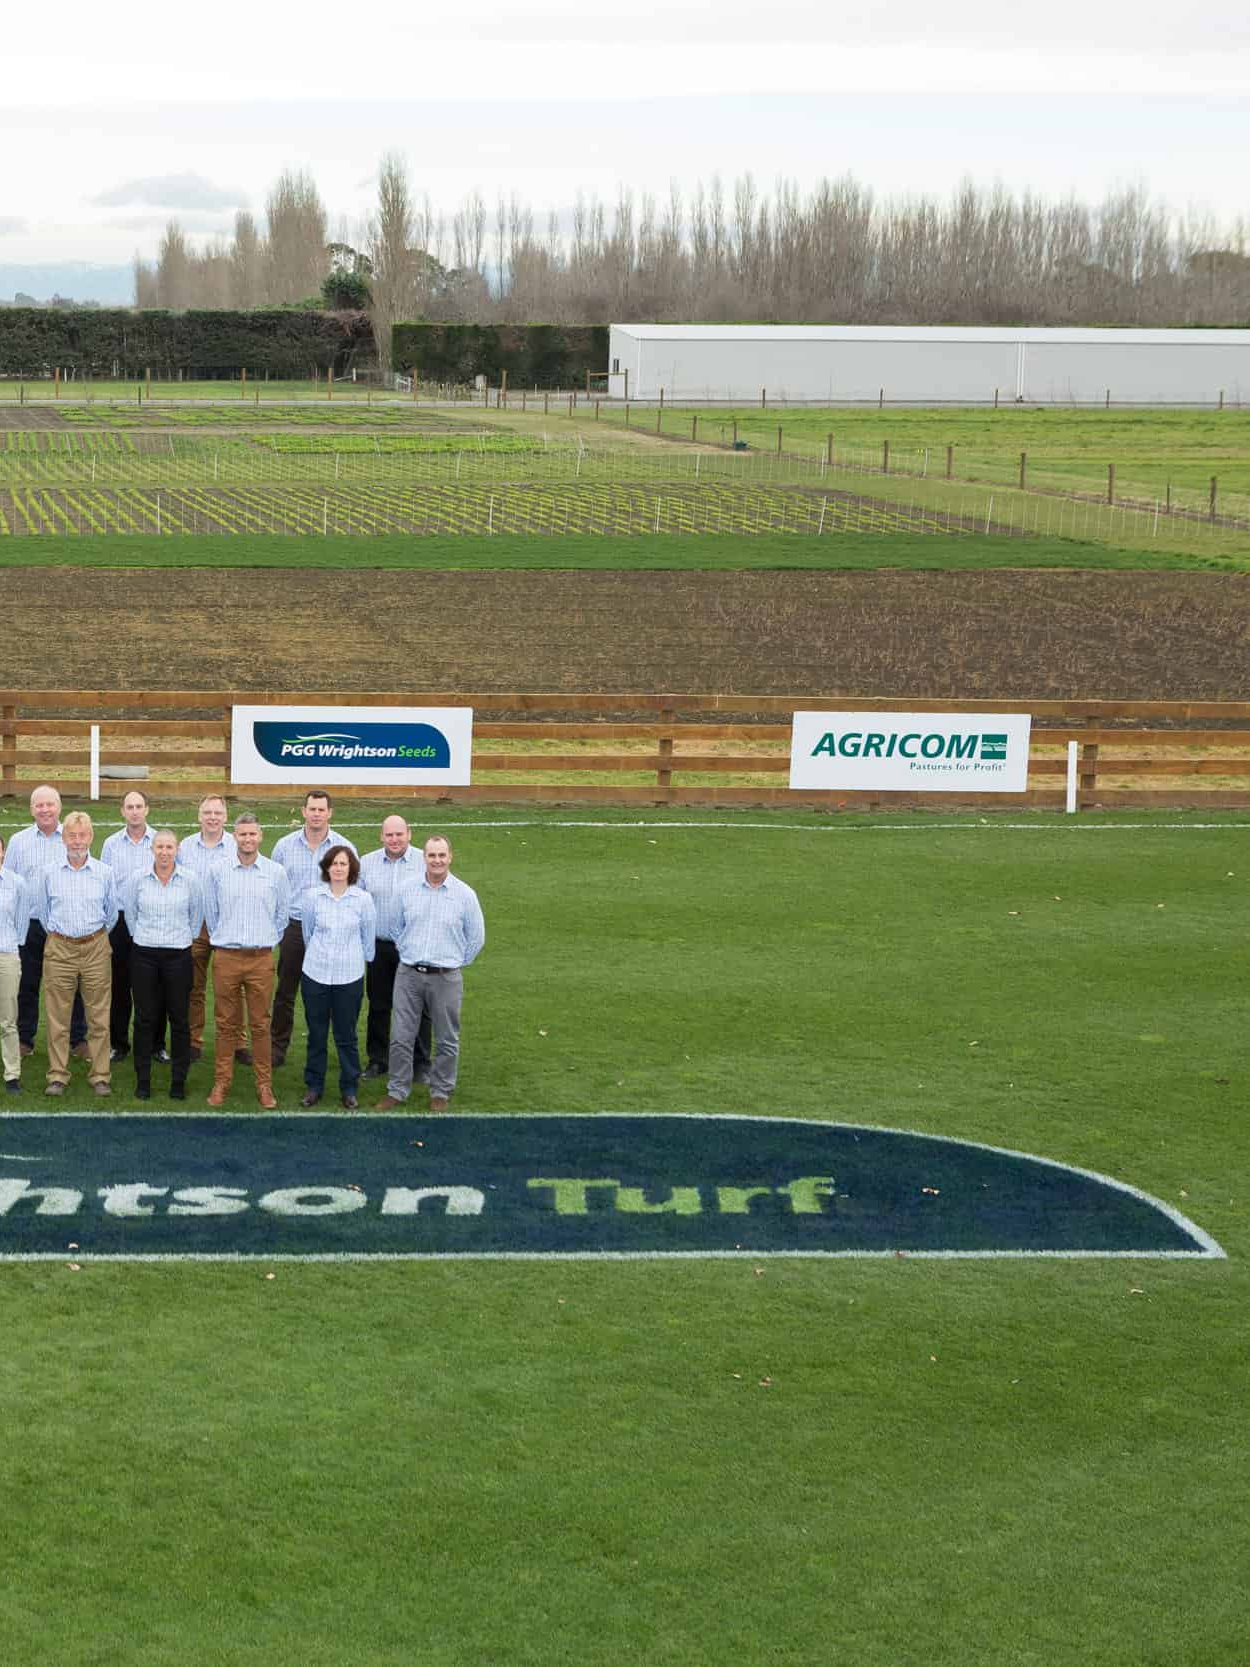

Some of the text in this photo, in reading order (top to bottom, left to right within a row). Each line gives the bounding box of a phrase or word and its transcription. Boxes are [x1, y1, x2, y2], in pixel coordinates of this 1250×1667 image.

[281, 744, 436, 760] PGG Wrightson Seeds
[810, 732, 979, 759] AGRICOM
[909, 762, 953, 771] Pastures
[955, 762, 970, 771] for
[527, 1177, 837, 1216] Turf
